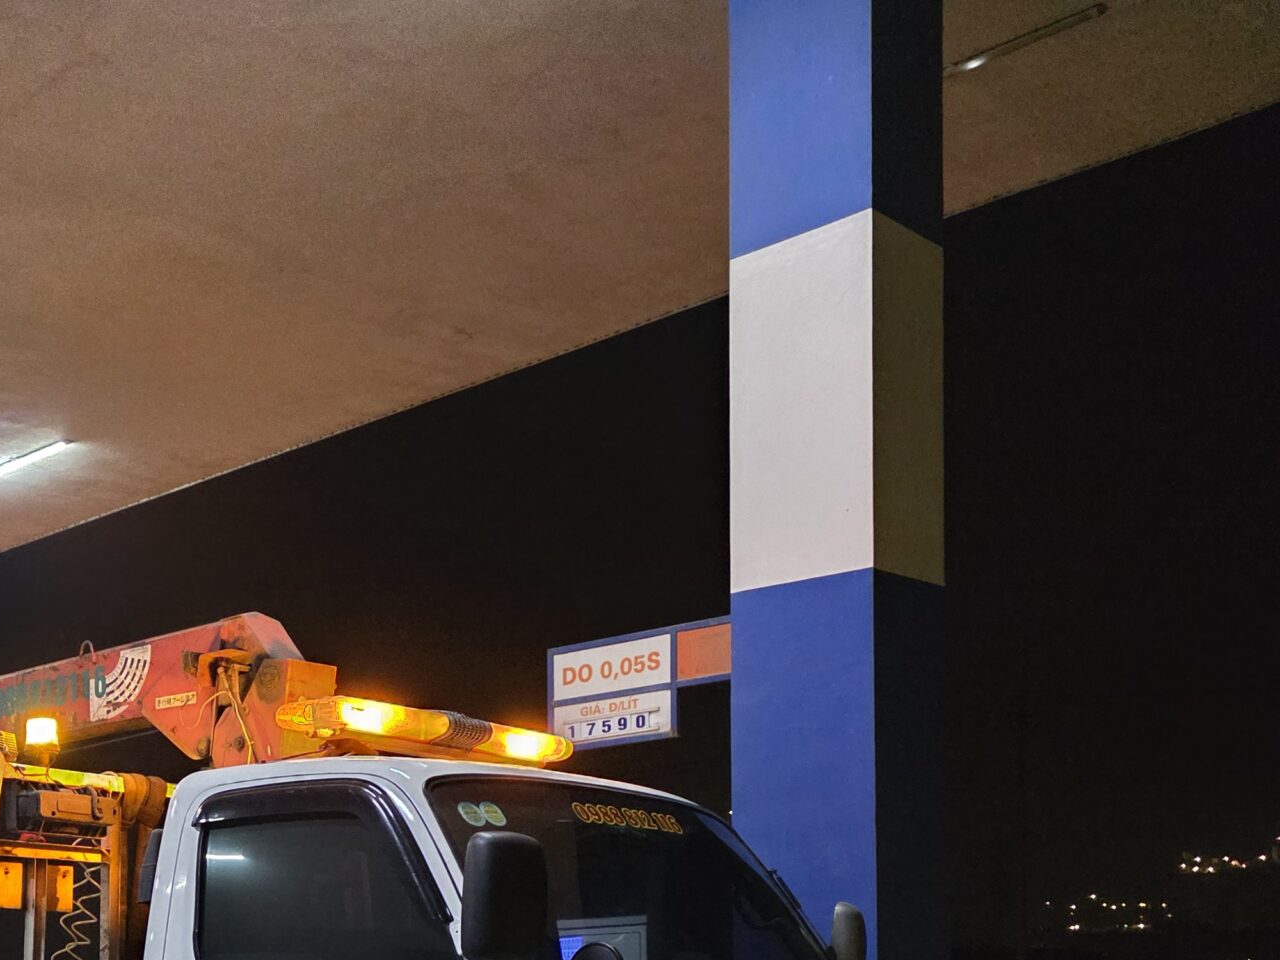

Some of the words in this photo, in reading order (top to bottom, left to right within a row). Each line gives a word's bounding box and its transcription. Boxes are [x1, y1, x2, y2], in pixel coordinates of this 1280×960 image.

[562, 663, 593, 686] DO
[600, 651, 661, 681] 0,05S
[579, 701, 606, 718] GIÁ:
[567, 714, 647, 739] 17590
[572, 802, 626, 826] 0988
